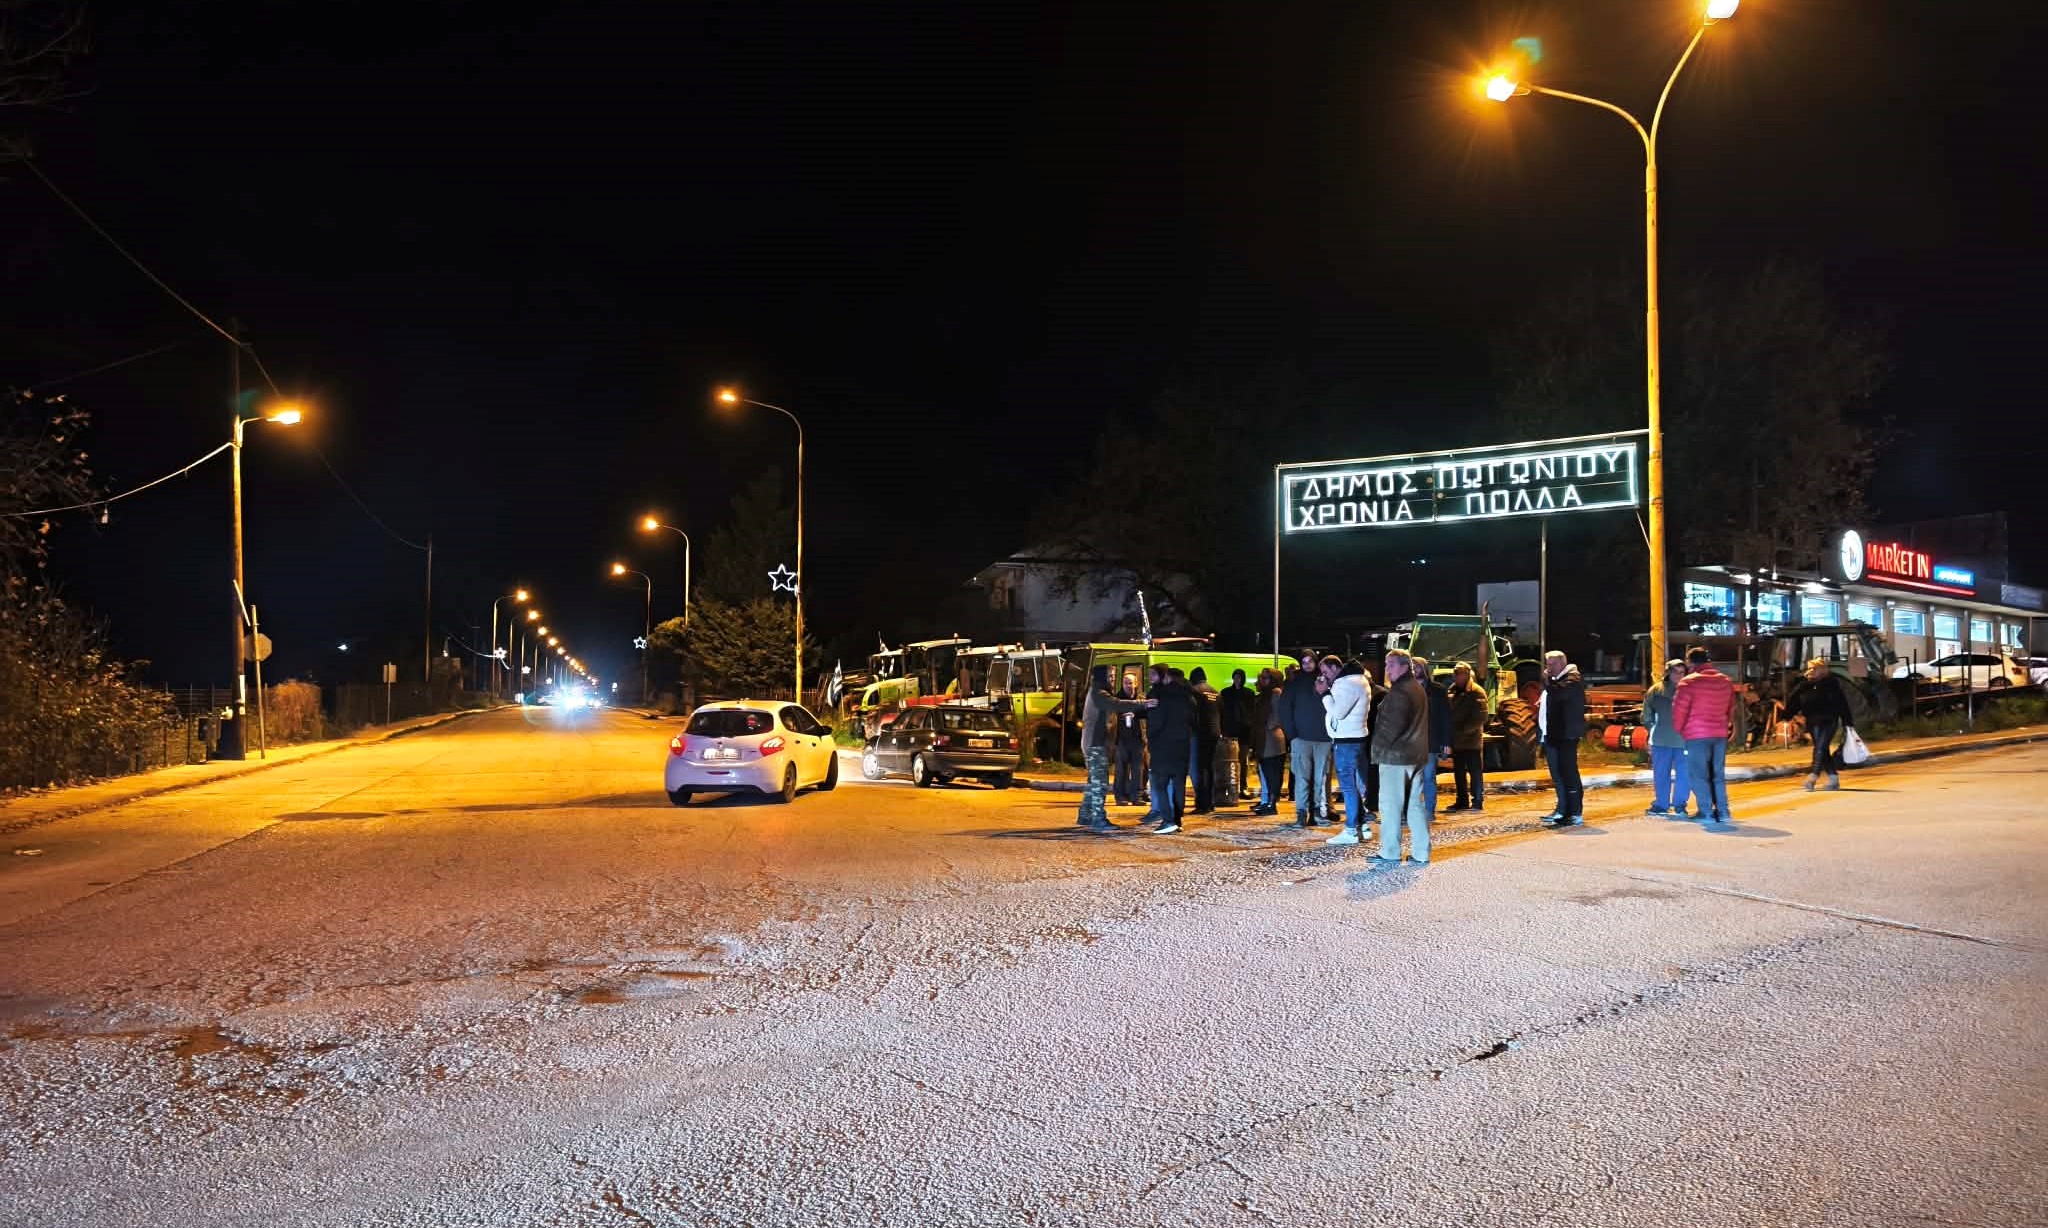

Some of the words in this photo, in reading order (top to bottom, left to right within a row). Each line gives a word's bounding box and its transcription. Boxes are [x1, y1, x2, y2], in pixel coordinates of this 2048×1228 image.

[1303, 471, 1417, 501] ΔΗΜΟΣ
[1438, 449, 1623, 489] ΠΩΓΩΝΙΟΥ
[1300, 499, 1413, 528] ΧΡΟΝΙΑ
[1466, 484, 1582, 515] ΠΟΛΛΑ
[1867, 543, 1914, 576] MARKET
[1917, 553, 1929, 579] IN
